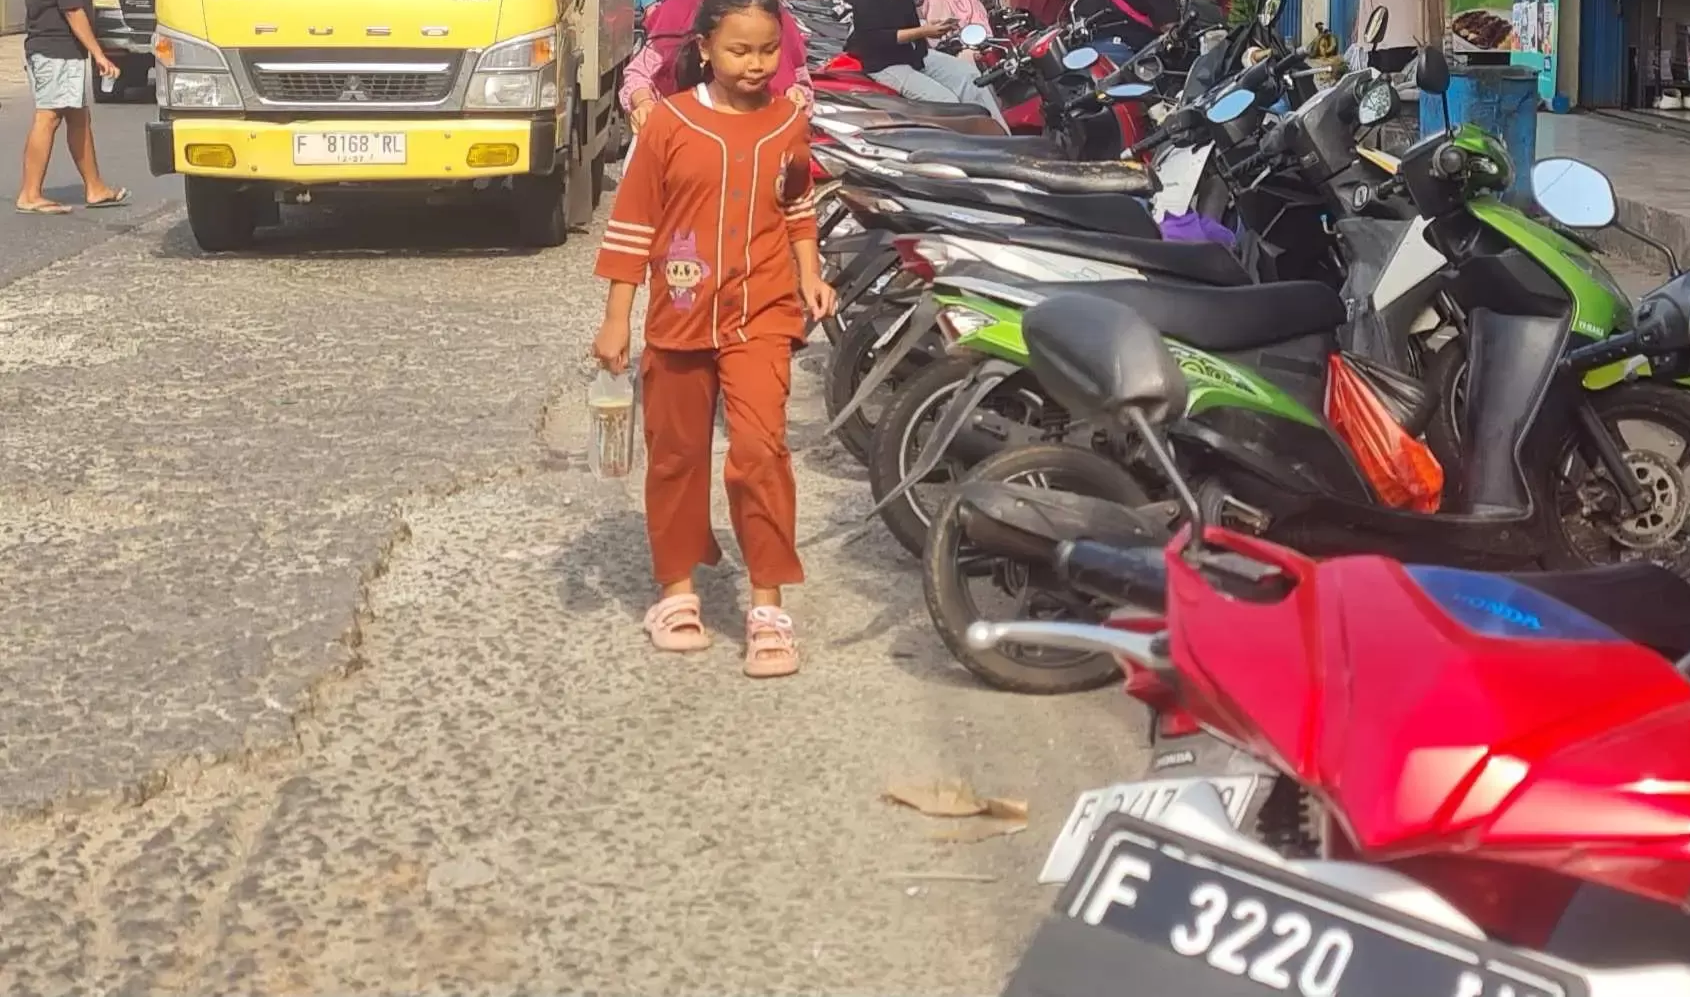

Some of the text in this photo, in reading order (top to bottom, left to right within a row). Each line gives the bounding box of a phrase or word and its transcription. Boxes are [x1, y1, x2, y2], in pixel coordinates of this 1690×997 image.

[254, 25, 449, 38] FUSO
[297, 135, 403, 154] F 8168 RL
[1453, 593, 1542, 631] HONDA
[1083, 854, 1354, 997] F 3220
